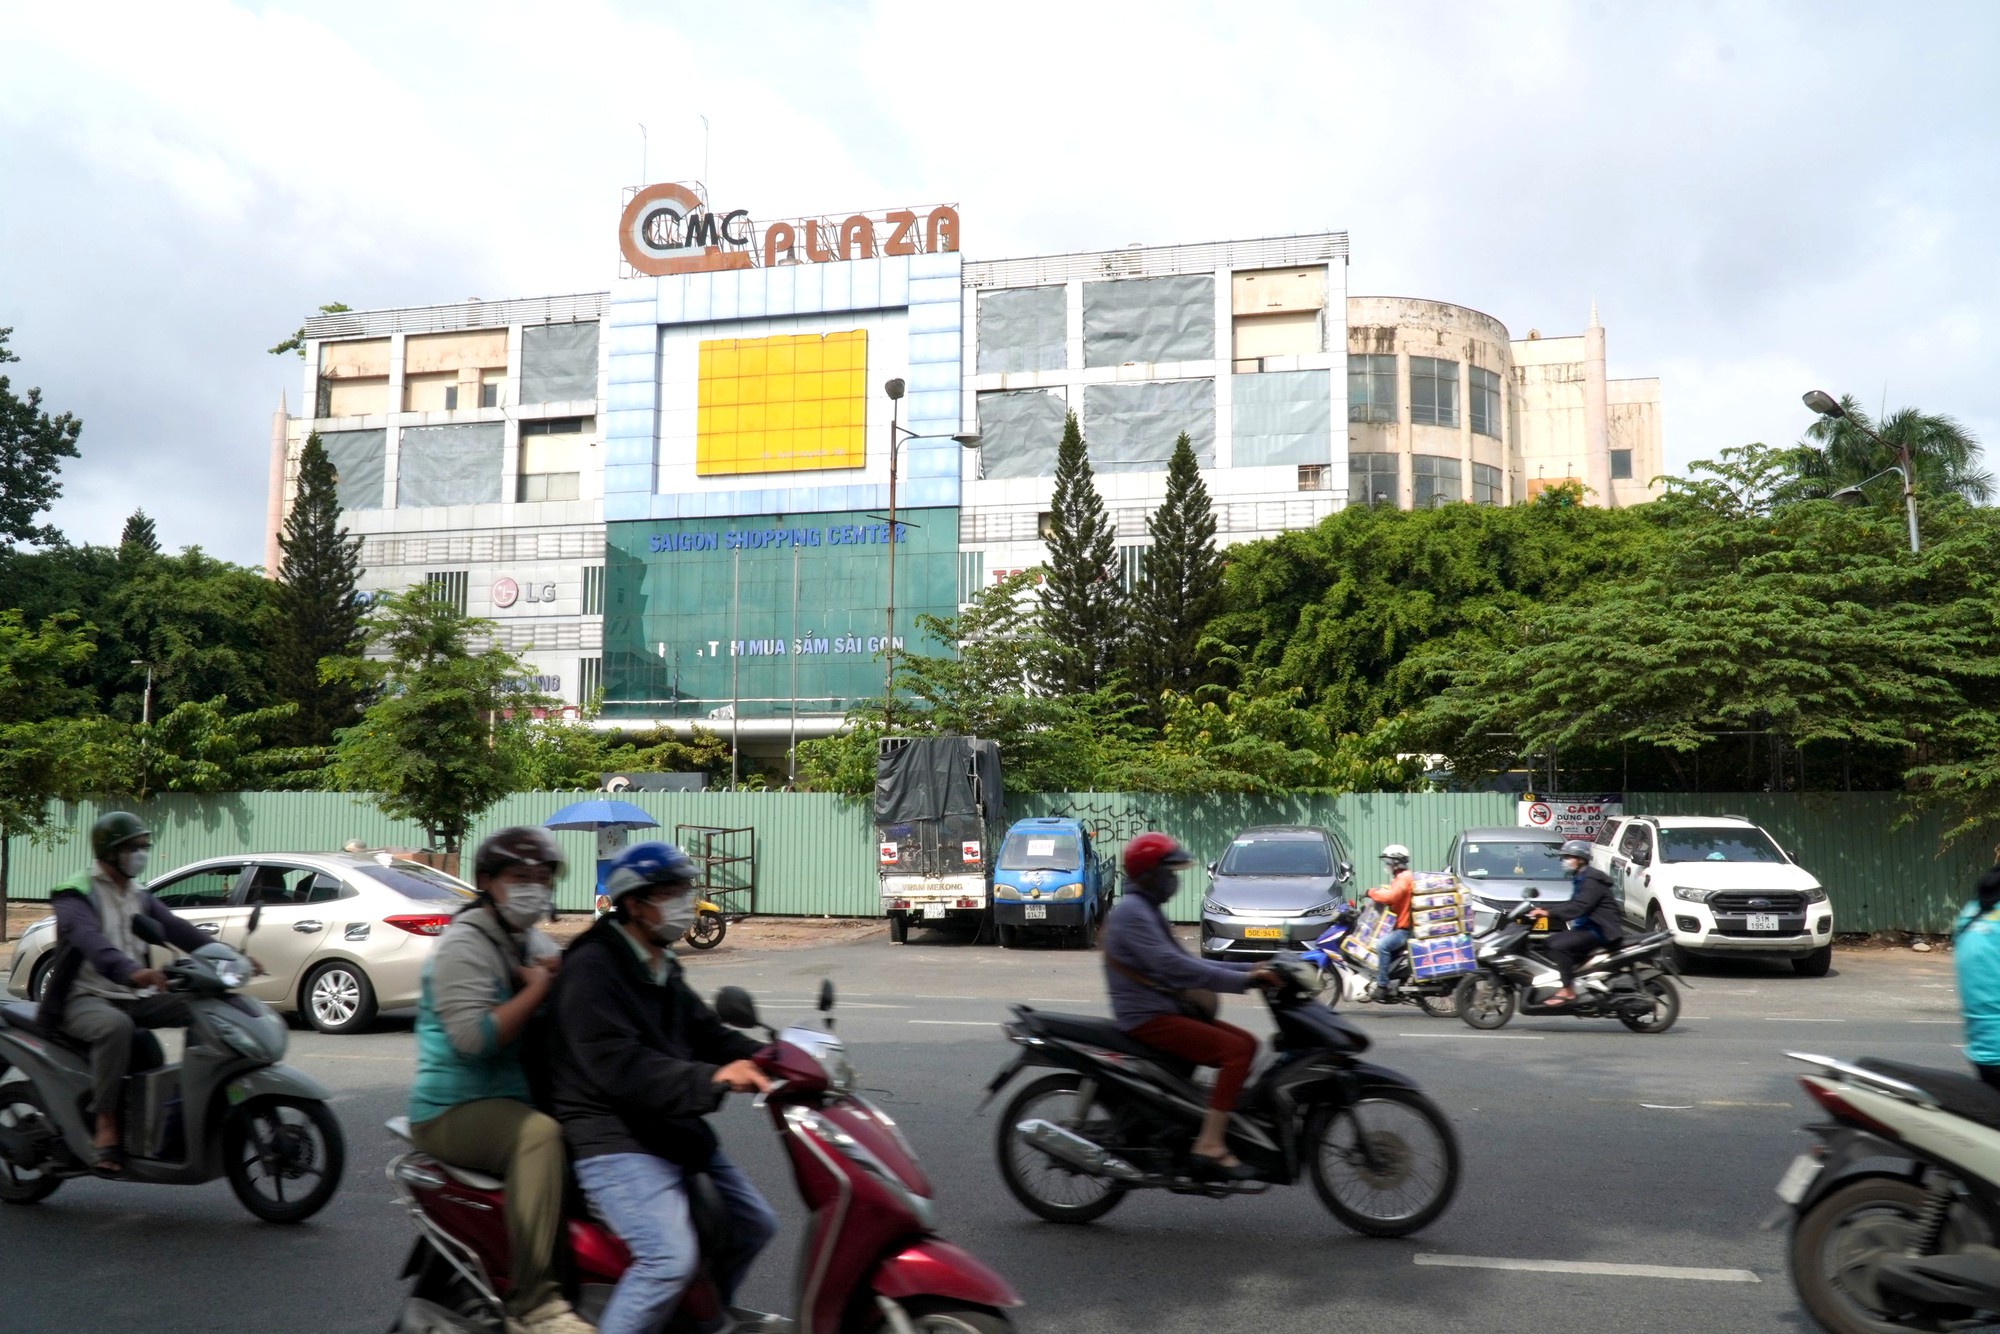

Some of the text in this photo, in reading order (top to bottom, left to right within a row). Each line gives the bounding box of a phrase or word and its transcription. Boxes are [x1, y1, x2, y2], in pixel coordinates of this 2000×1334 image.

[764, 206, 960, 266] PLAZA
[648, 523, 907, 553] SAIGON SHOPPING CENTER
[525, 581, 556, 603] LG
[749, 639, 786, 656] MUA
[792, 629, 829, 655] SẮM
[834, 632, 862, 654] SÀI
[926, 883, 963, 891] MEKONG
